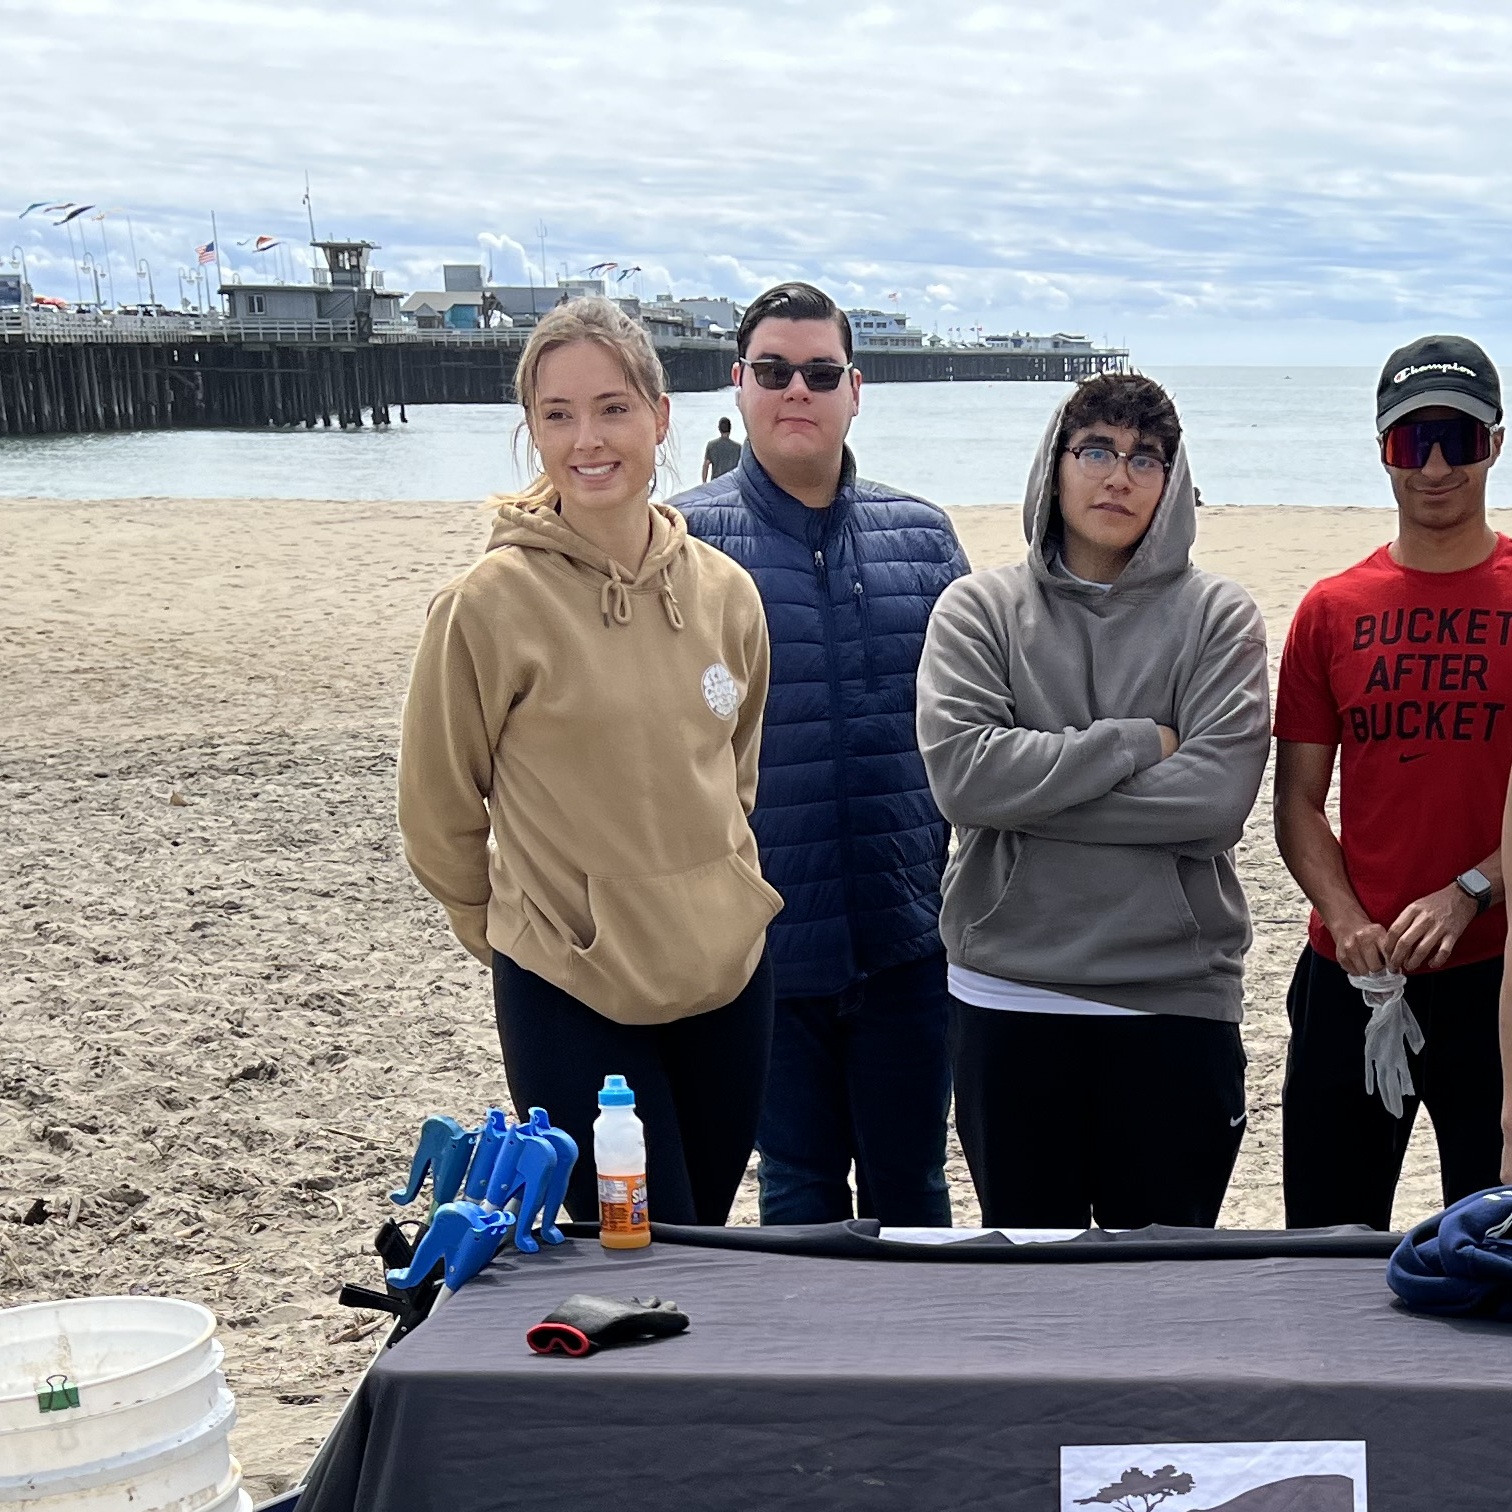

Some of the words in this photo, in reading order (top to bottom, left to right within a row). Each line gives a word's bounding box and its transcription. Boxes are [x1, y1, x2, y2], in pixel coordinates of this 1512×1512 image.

[1393, 362, 1477, 384] Champion
[1364, 653, 1490, 694] AFTER
[1350, 700, 1506, 744] BUCKET
